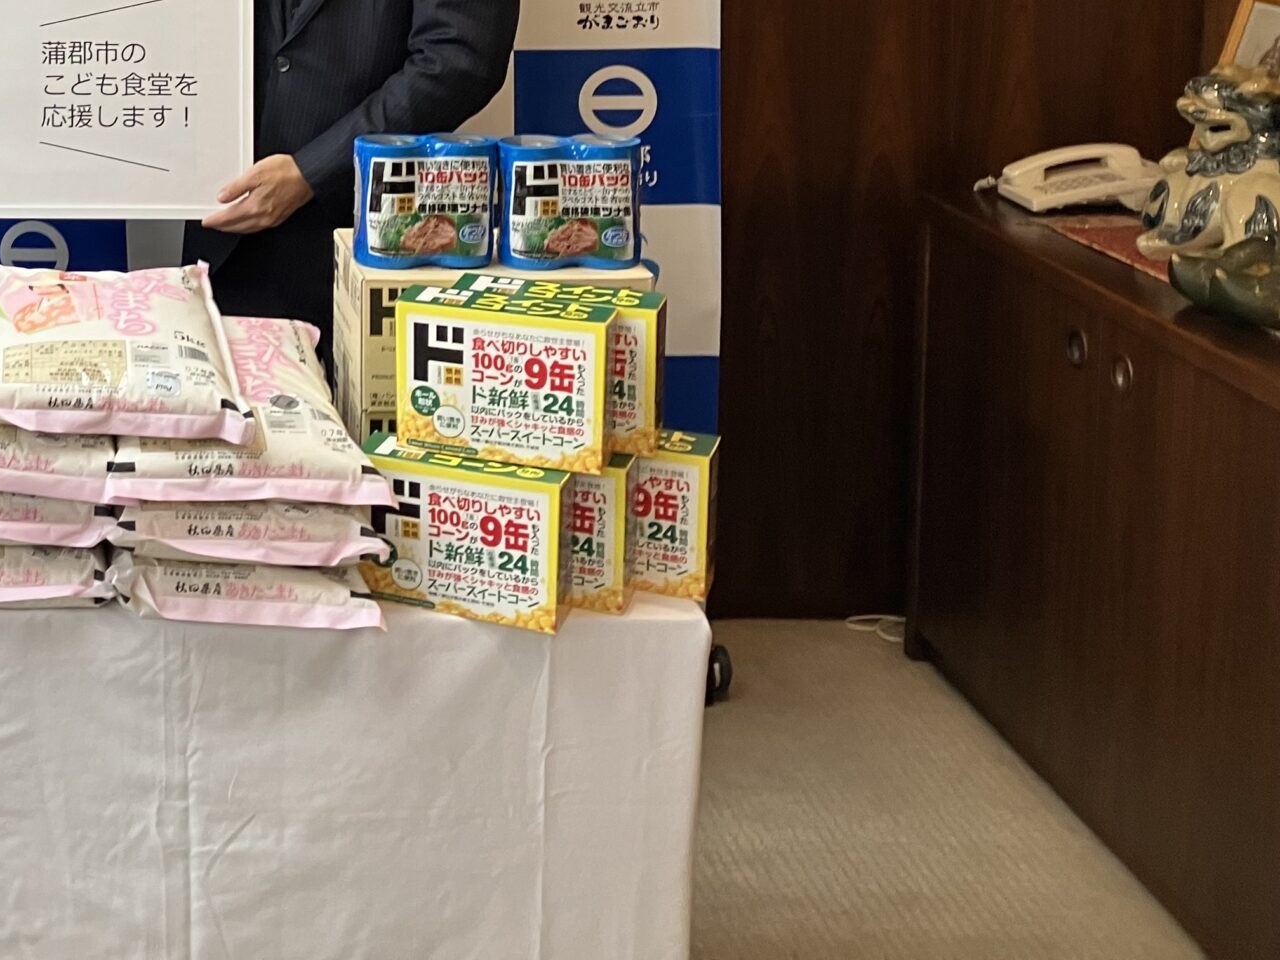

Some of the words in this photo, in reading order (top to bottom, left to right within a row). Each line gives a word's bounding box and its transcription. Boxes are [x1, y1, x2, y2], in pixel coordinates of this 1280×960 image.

[579, 1, 659, 15] 観光交流立市
[577, 13, 660, 30] がまごおり
[41, 41, 146, 65] 蒲郡市の
[43, 72, 198, 97] こども食堂を
[40, 105, 191, 128] 応援します！
[418, 171, 488, 183] 10缶パック
[562, 175, 629, 187] 10缶パック
[472, 337, 587, 361] 食べ切りしやすい
[524, 358, 575, 393] 9缶
[543, 393, 575, 416] 24
[471, 425, 586, 449] スーパースイートコーン
[428, 453, 518, 472] コーン
[428, 492, 540, 521] 食べ切りしやすい
[480, 515, 530, 553] 9缶
[648, 522, 678, 543] 24
[498, 551, 530, 575] 24
[427, 579, 540, 608] スーパースイートコーン
